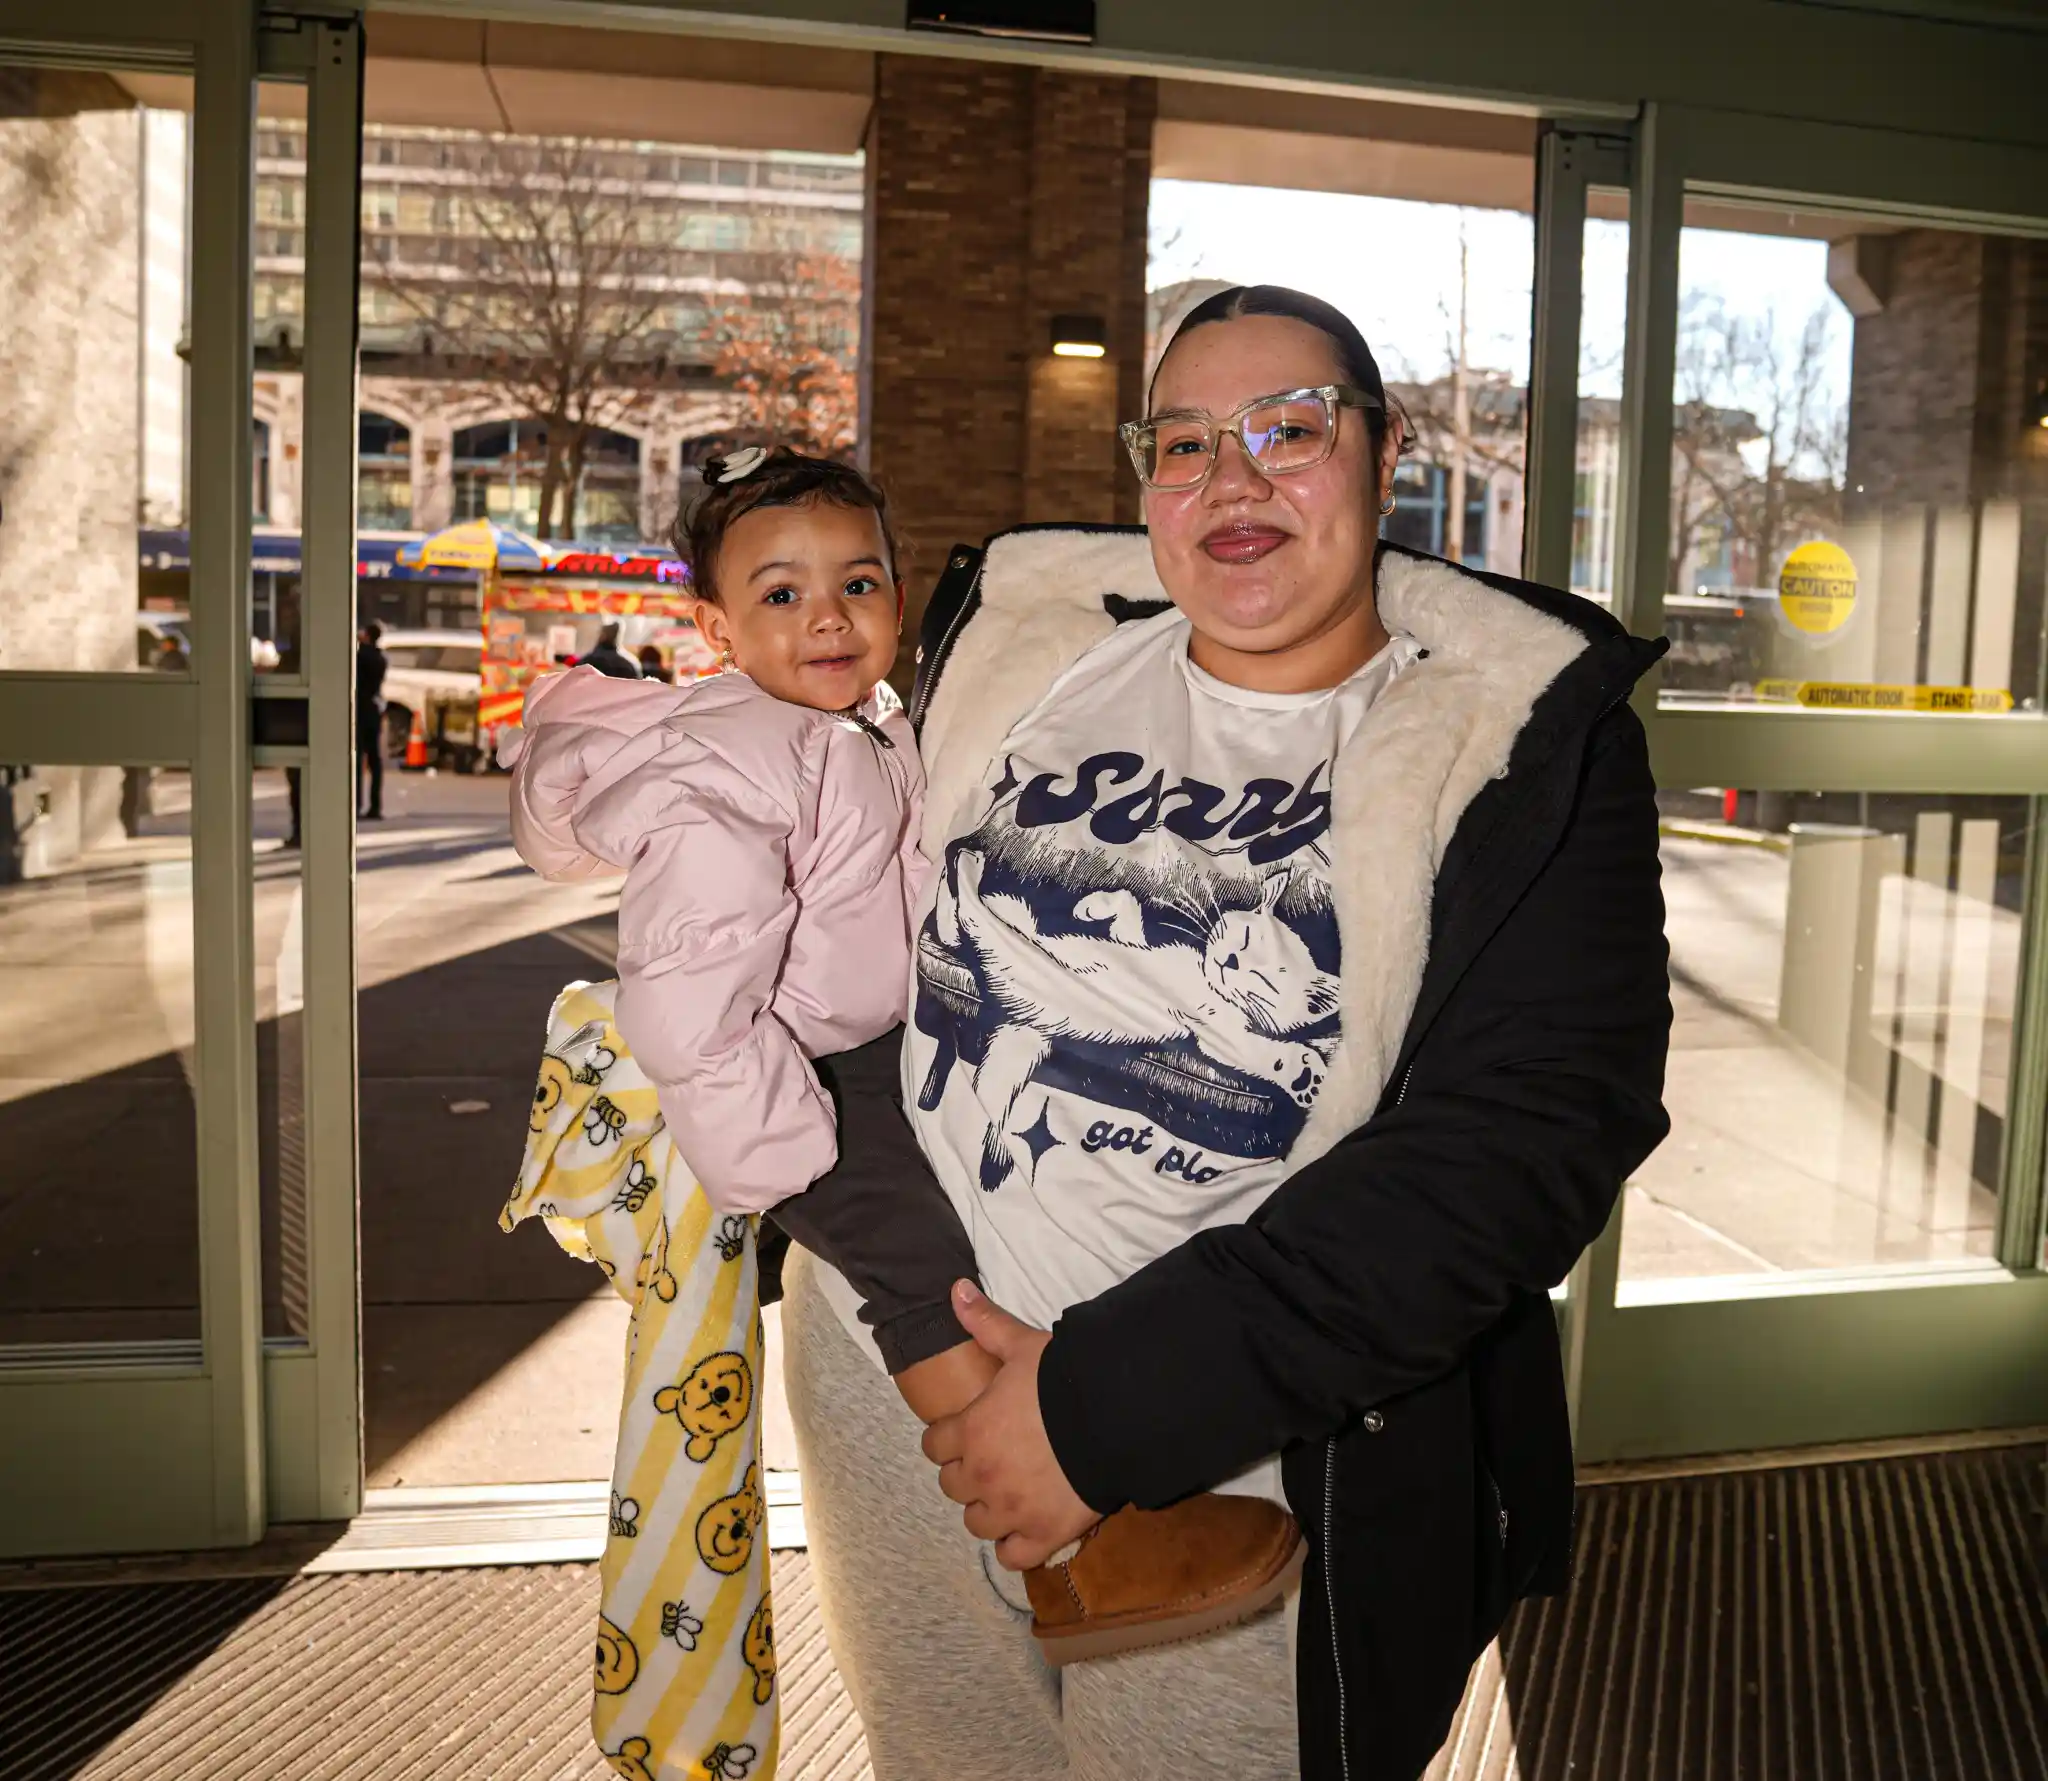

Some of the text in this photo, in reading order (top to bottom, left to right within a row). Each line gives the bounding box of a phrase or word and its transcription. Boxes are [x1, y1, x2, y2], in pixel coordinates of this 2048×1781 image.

[1782, 578, 1854, 597] CAUTION
[1808, 689, 1872, 706] AUTOMATIC
[1875, 691, 1904, 707] DOOR
[1931, 691, 1966, 708] STAND
[1967, 693, 2000, 710] CLEAR
[1080, 1120, 1154, 1154] got
